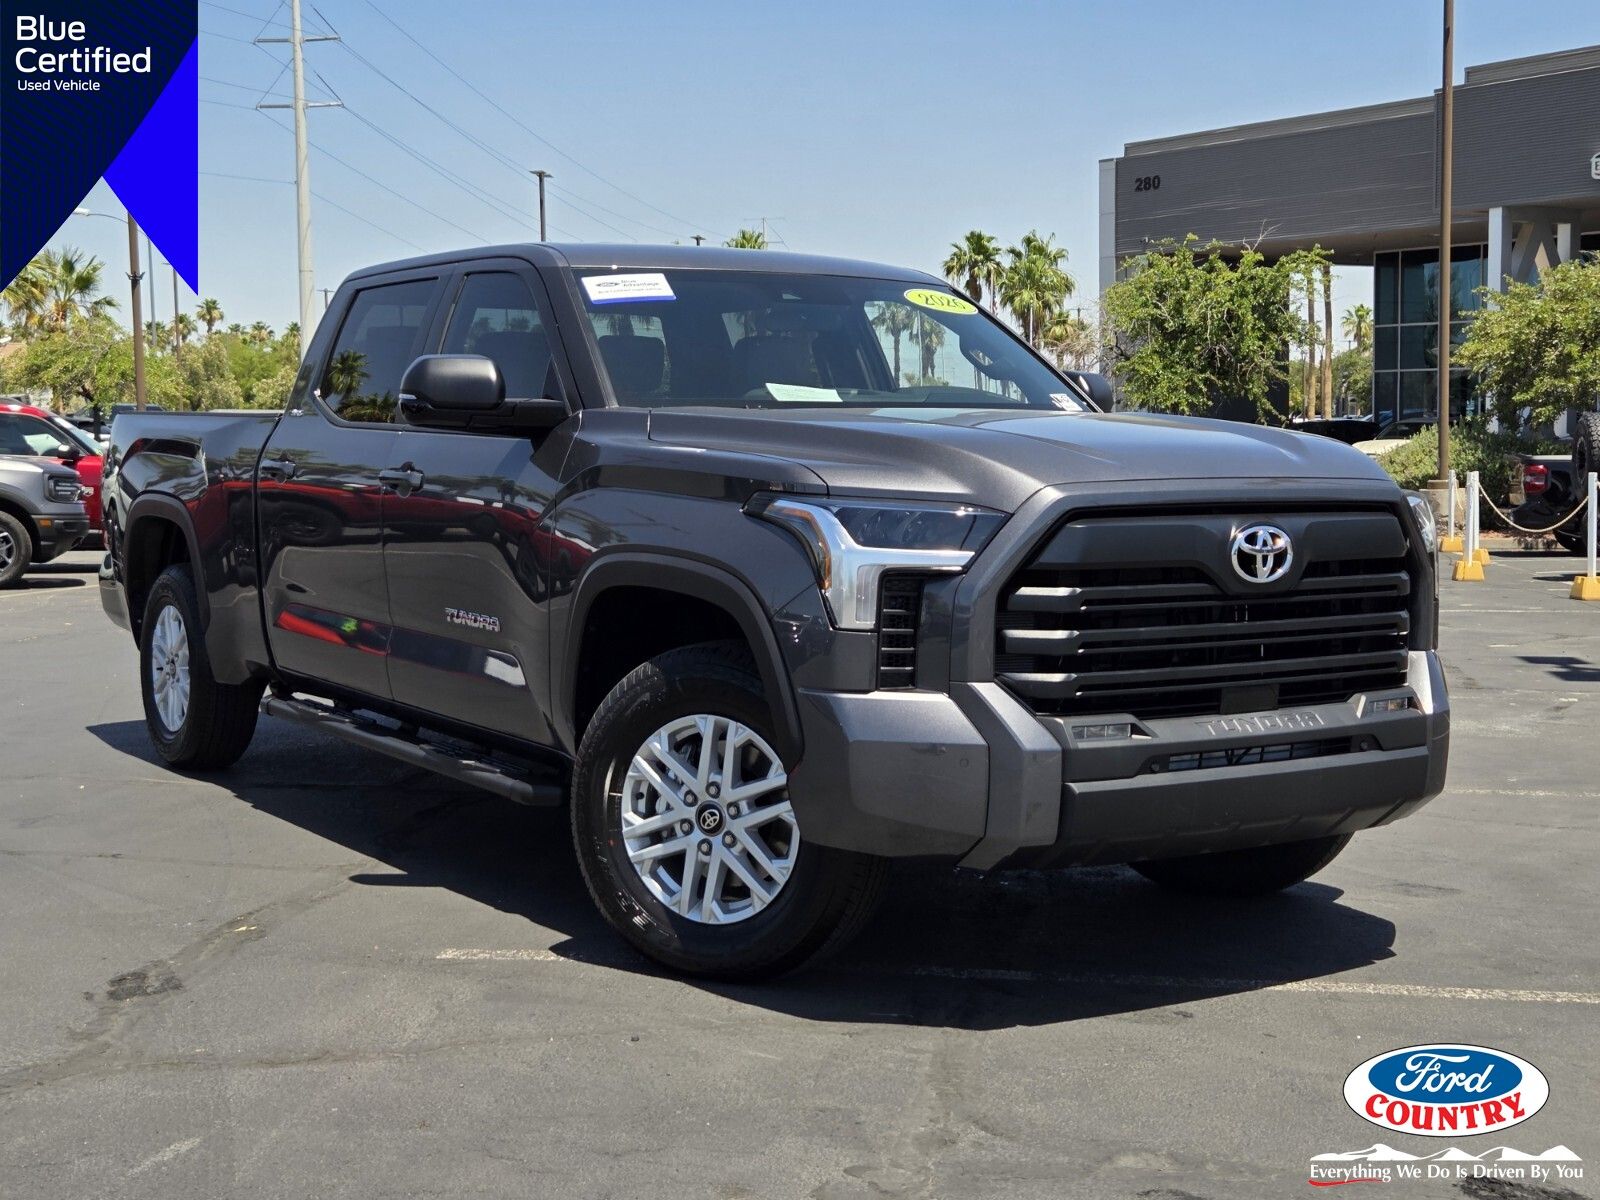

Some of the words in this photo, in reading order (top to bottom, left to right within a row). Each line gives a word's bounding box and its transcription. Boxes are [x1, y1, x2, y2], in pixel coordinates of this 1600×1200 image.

[1134, 175, 1161, 193] 280
[445, 607, 501, 633] TUNDRA
[1194, 711, 1325, 736] TUNDRA
